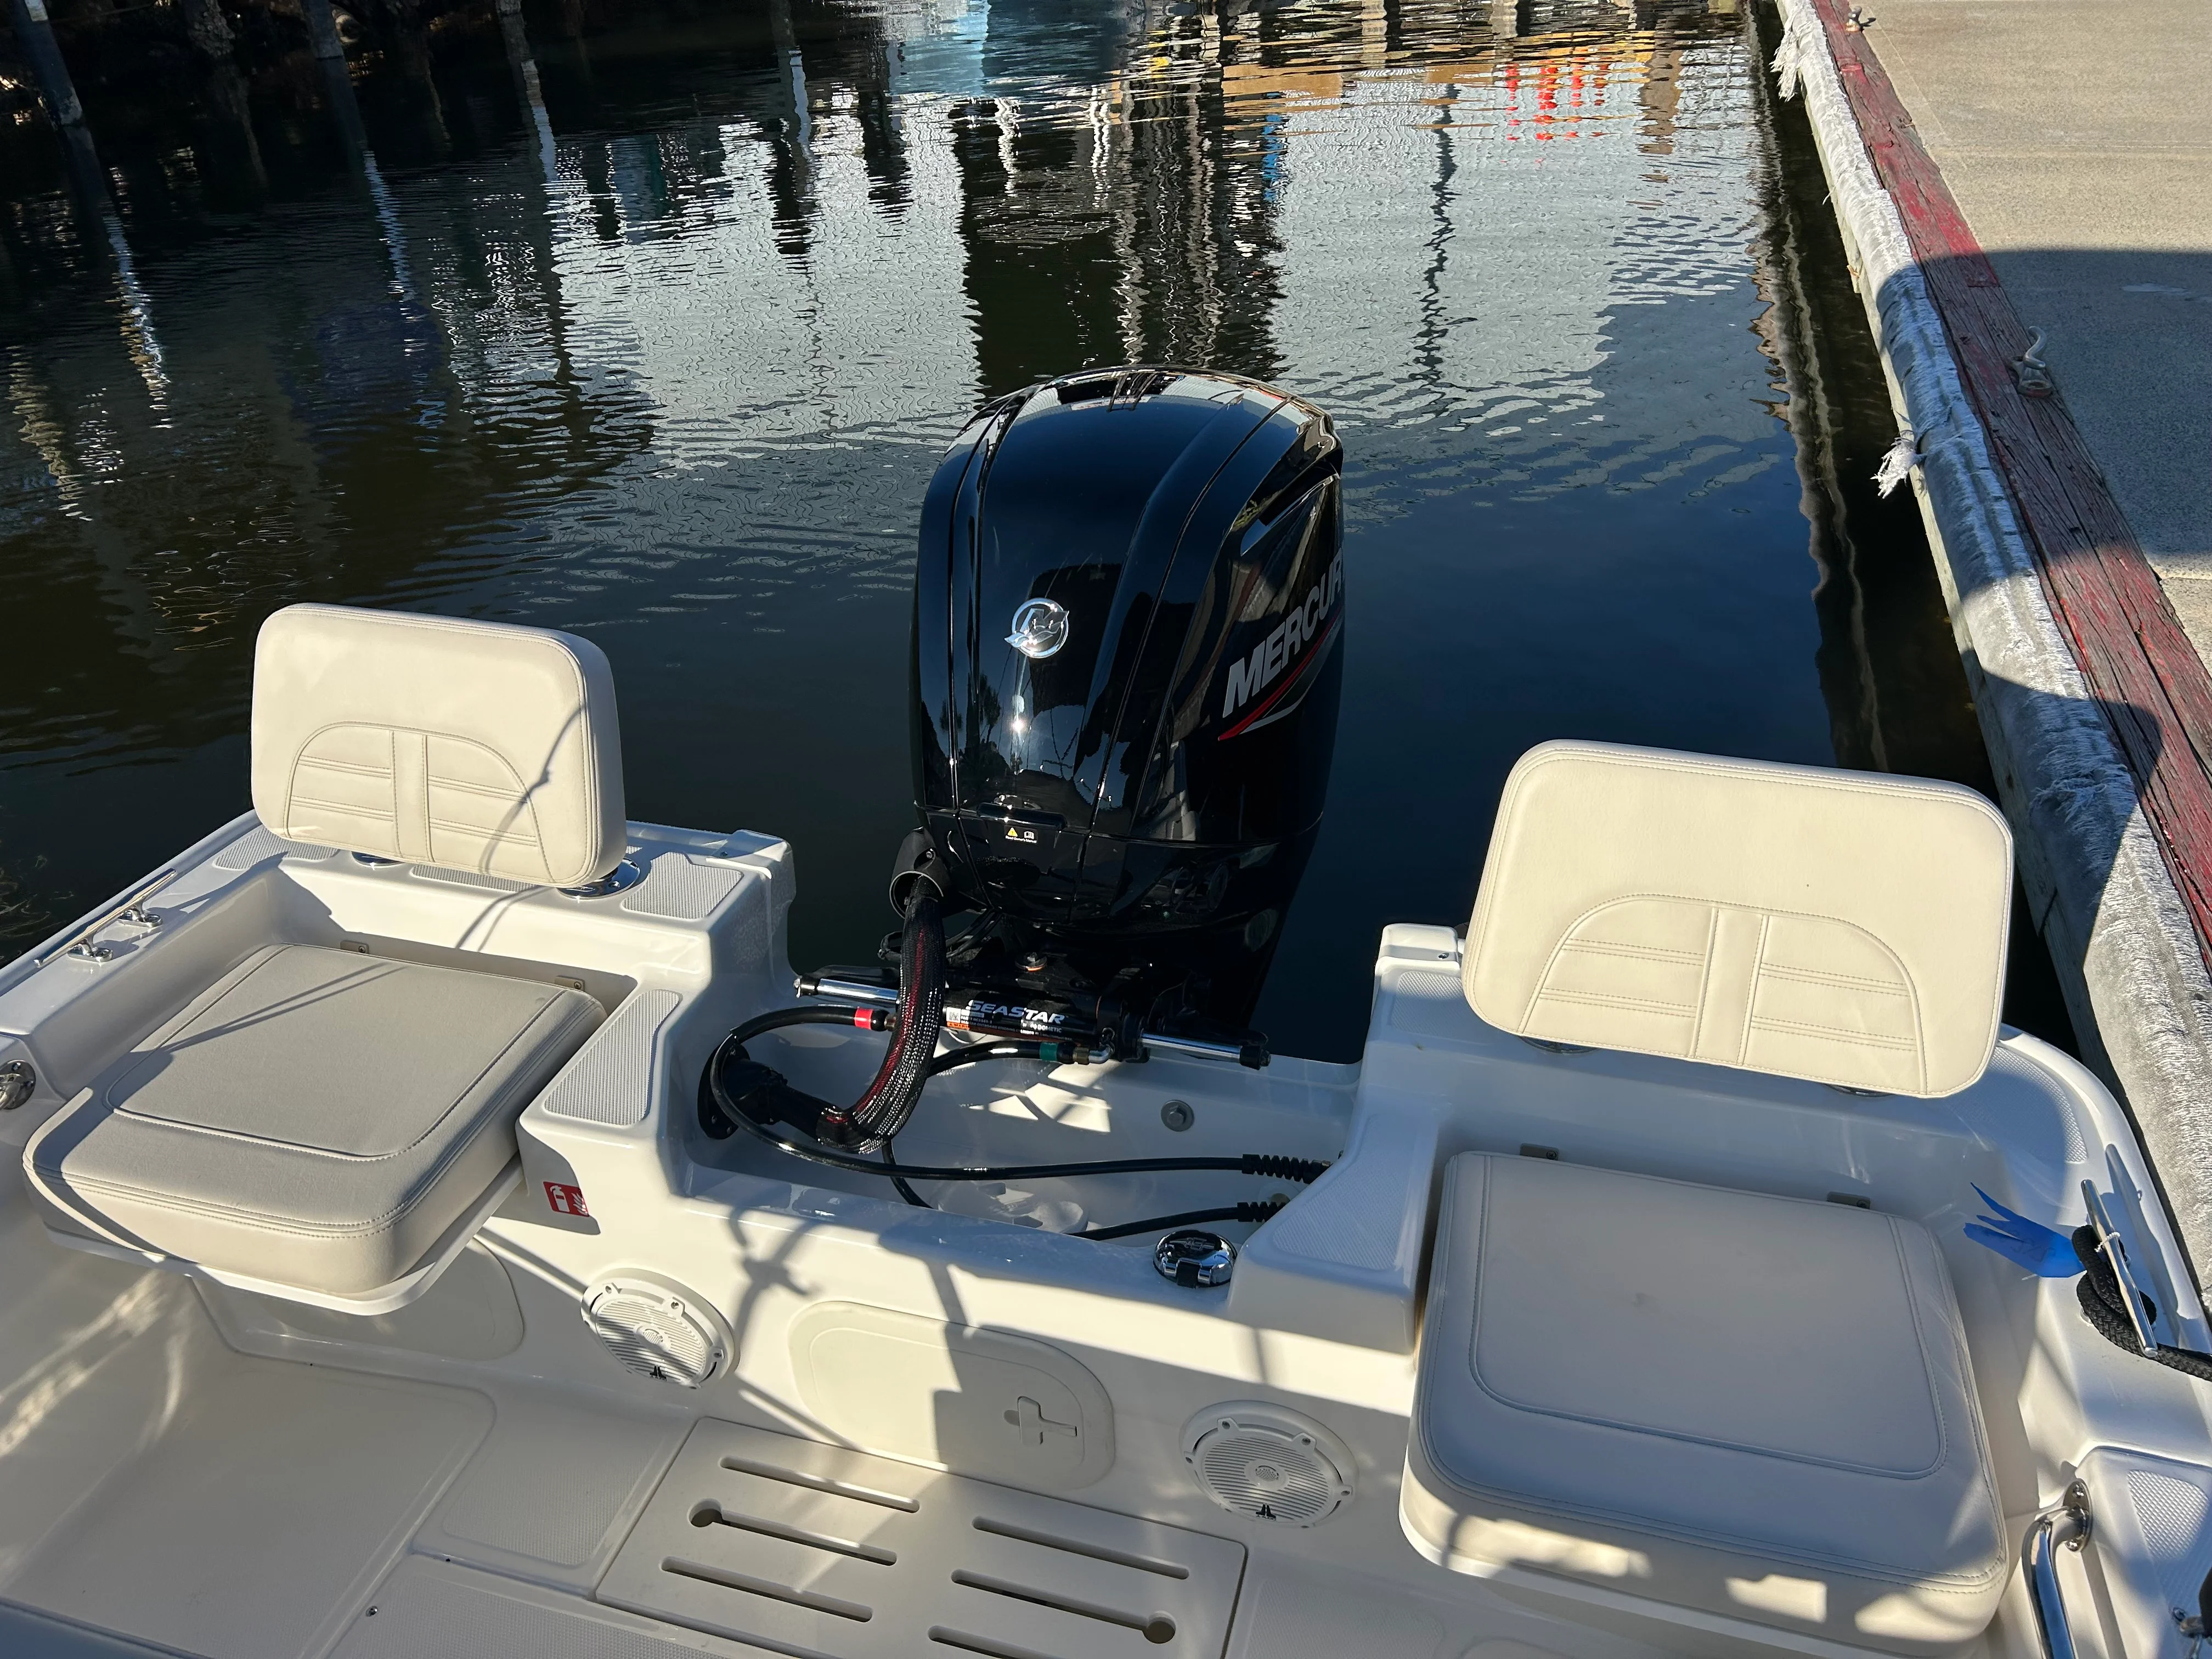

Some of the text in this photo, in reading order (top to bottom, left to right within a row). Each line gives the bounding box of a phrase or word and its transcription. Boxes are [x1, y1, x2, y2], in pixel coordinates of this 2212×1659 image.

[1222, 548, 1344, 718] MERCUR
[966, 1000, 1065, 1024] SEASTAR
[1037, 1024, 1062, 1033] DOMETIC
